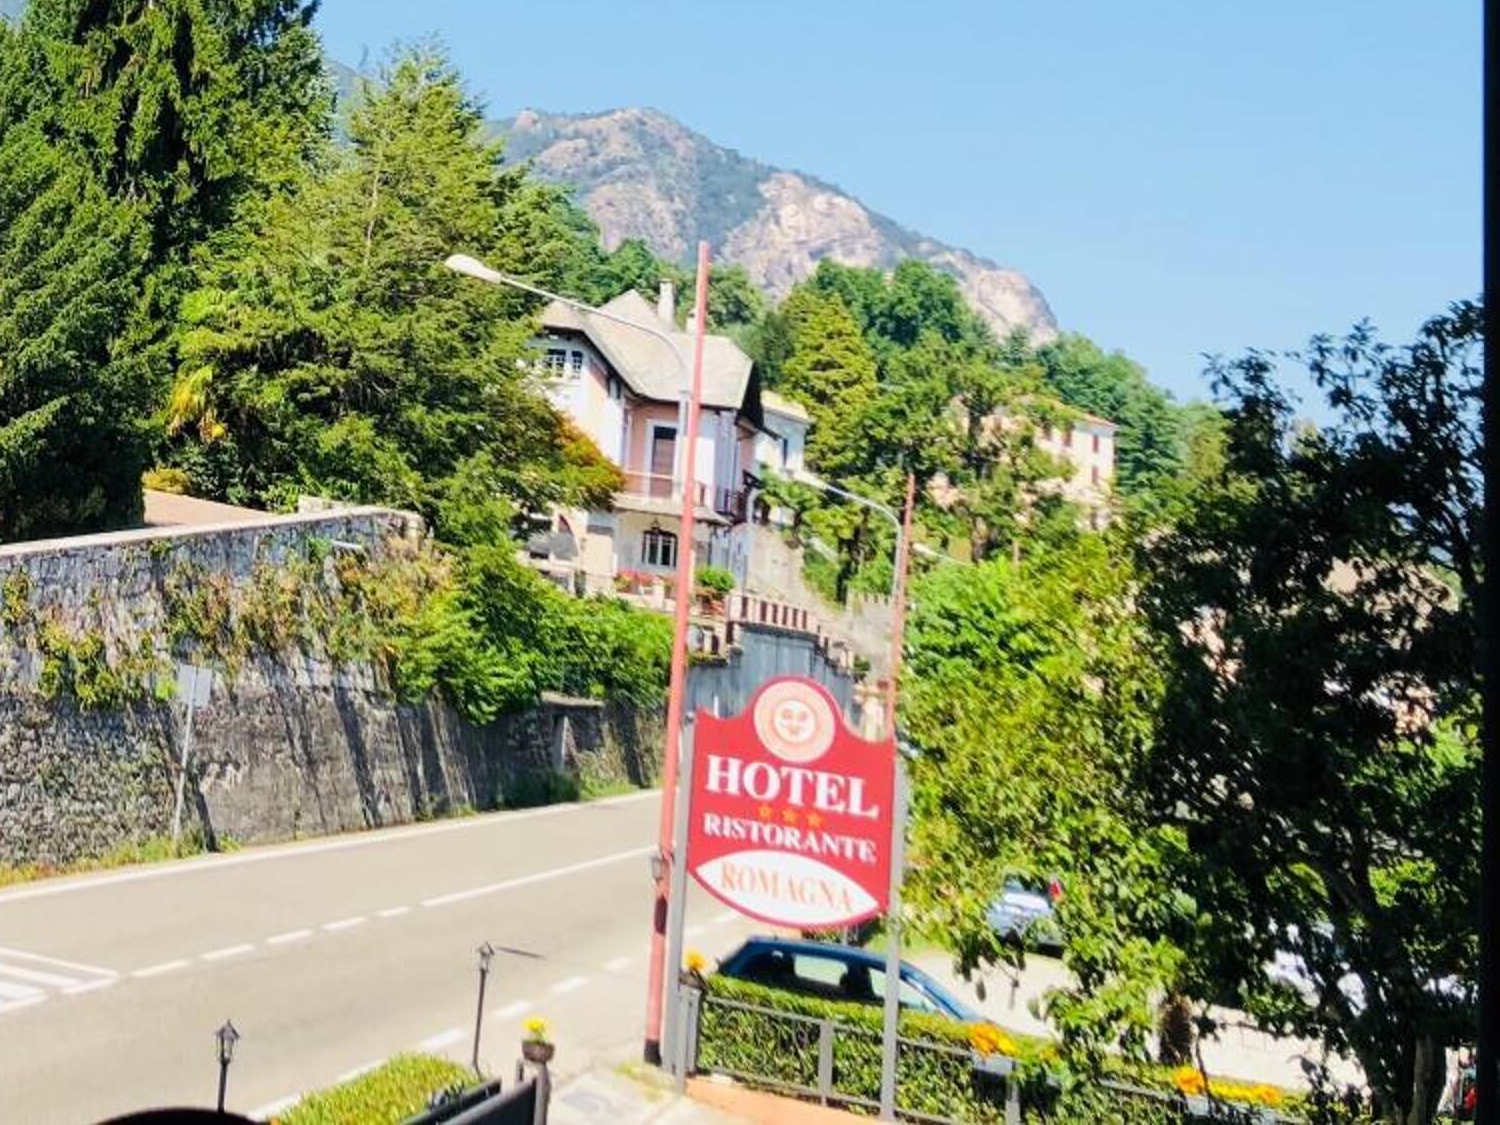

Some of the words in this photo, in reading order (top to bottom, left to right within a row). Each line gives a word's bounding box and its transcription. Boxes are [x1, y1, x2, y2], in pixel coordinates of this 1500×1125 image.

[705, 755, 879, 818] HOTEL
[704, 813, 877, 862] RISTORANTE
[721, 862, 853, 912] ROMAGNA
